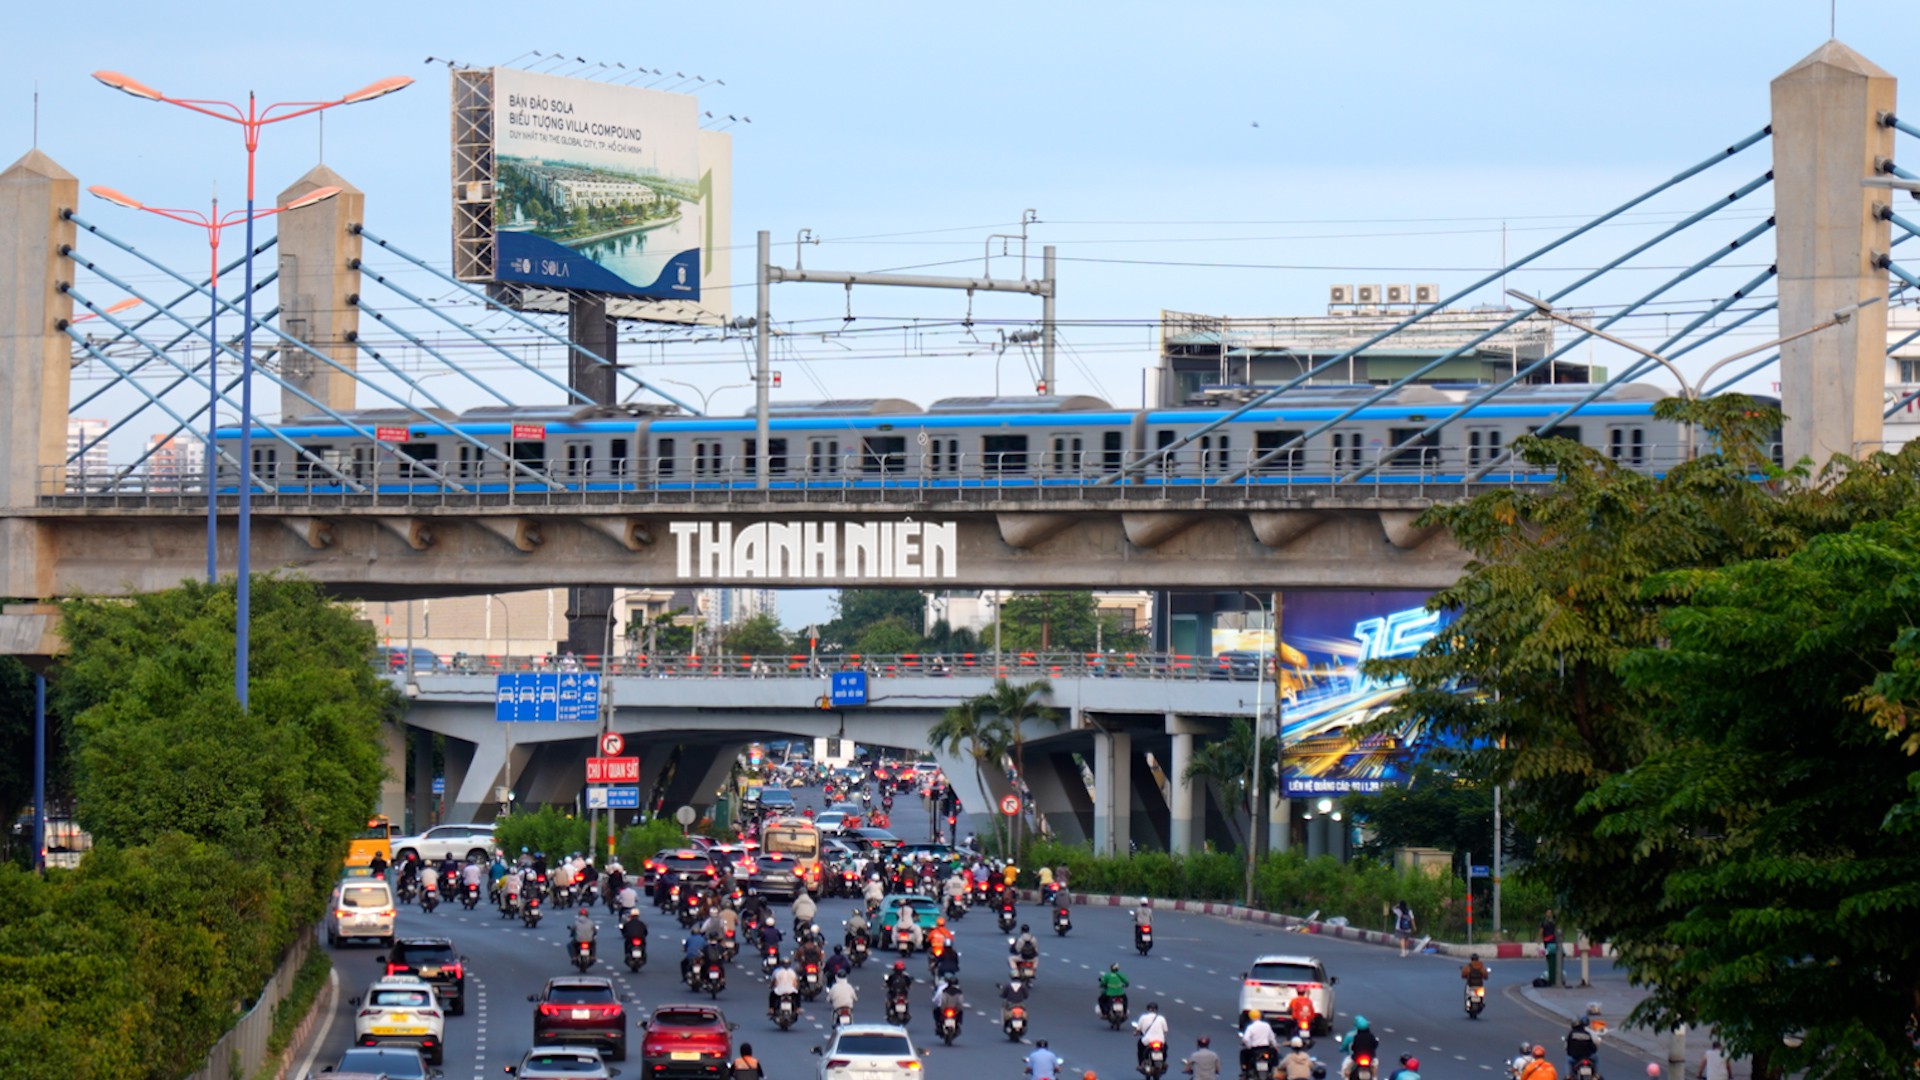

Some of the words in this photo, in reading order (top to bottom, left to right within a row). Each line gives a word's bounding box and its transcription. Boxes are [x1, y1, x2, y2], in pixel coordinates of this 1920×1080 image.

[551, 99, 574, 114] SOLA
[565, 118, 590, 134] VILLA
[591, 122, 641, 141] COMPOUND
[608, 762, 626, 779] QUAN
